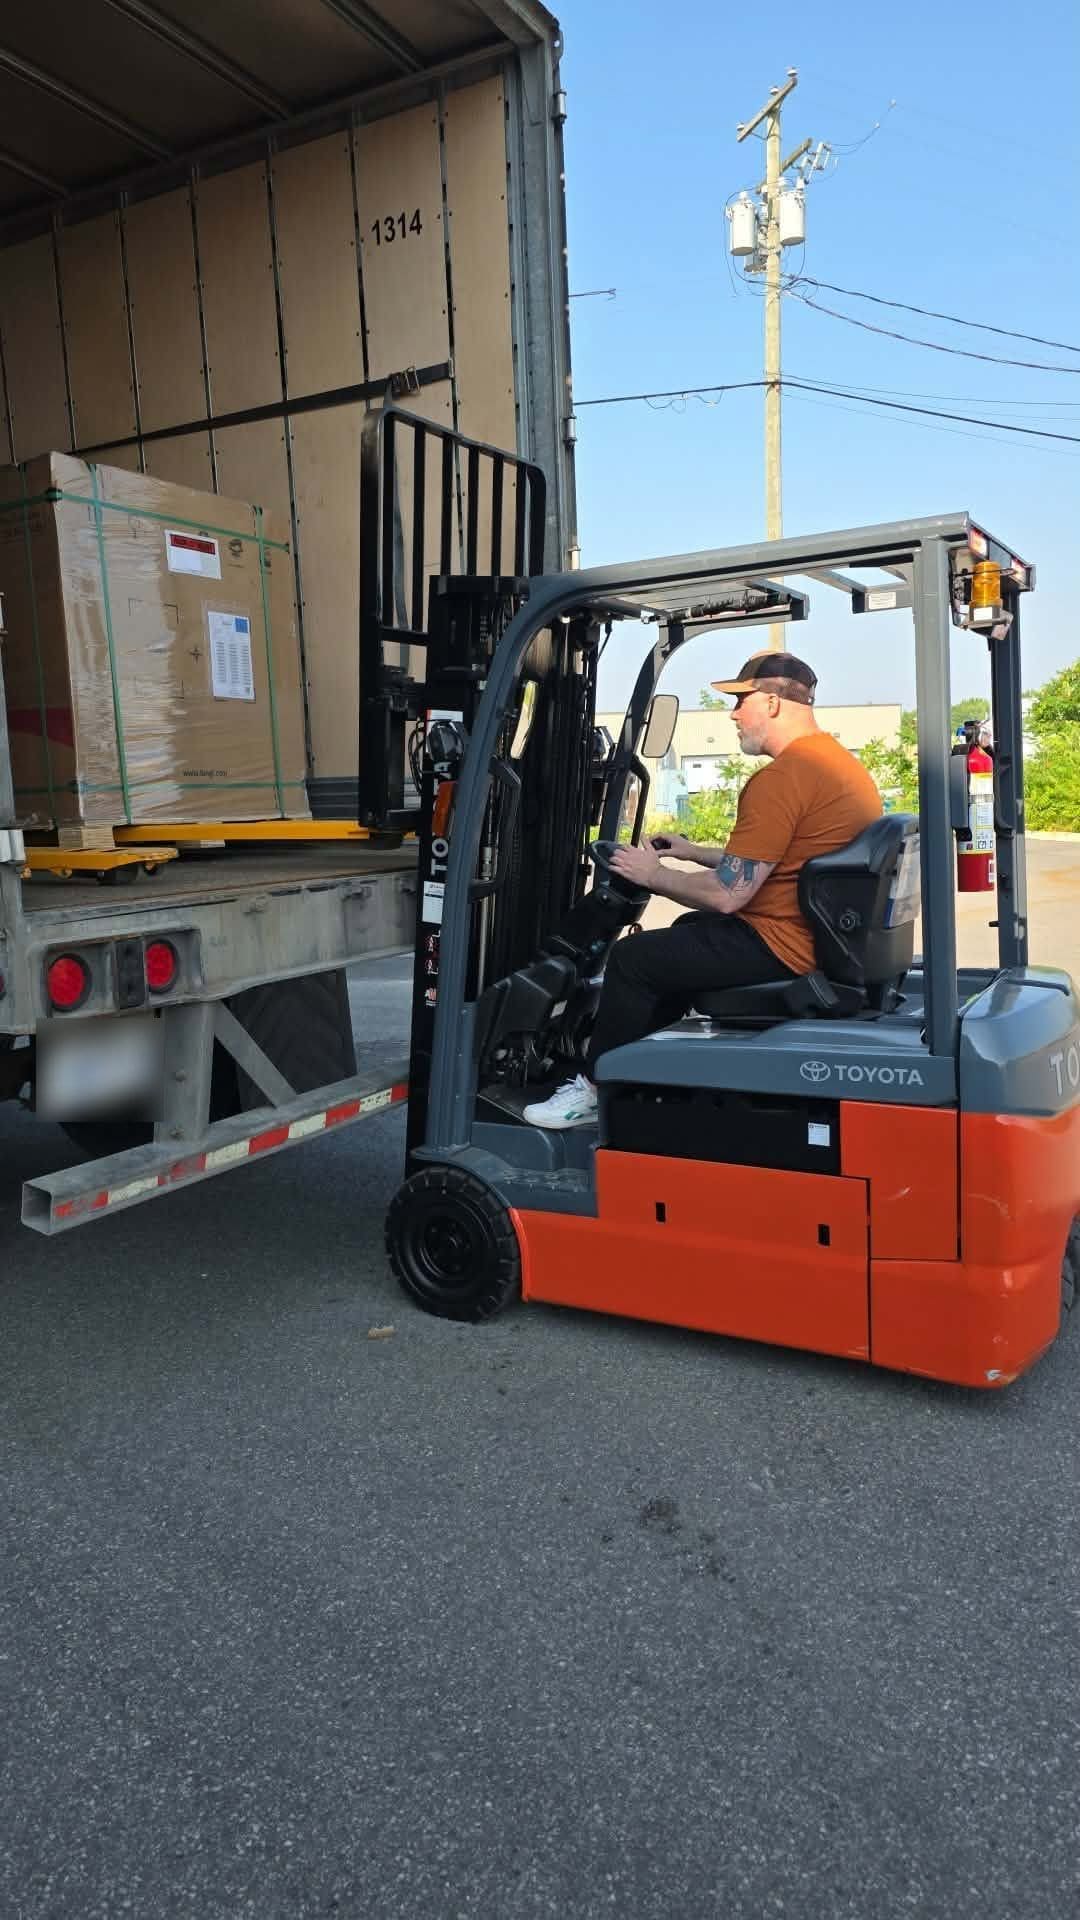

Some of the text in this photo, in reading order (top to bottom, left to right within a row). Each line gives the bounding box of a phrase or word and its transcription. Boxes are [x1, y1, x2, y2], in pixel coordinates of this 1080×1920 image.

[371, 208, 422, 246] 1314
[834, 1064, 924, 1086] TOYOTA
[1049, 1043, 1080, 1096] TO
